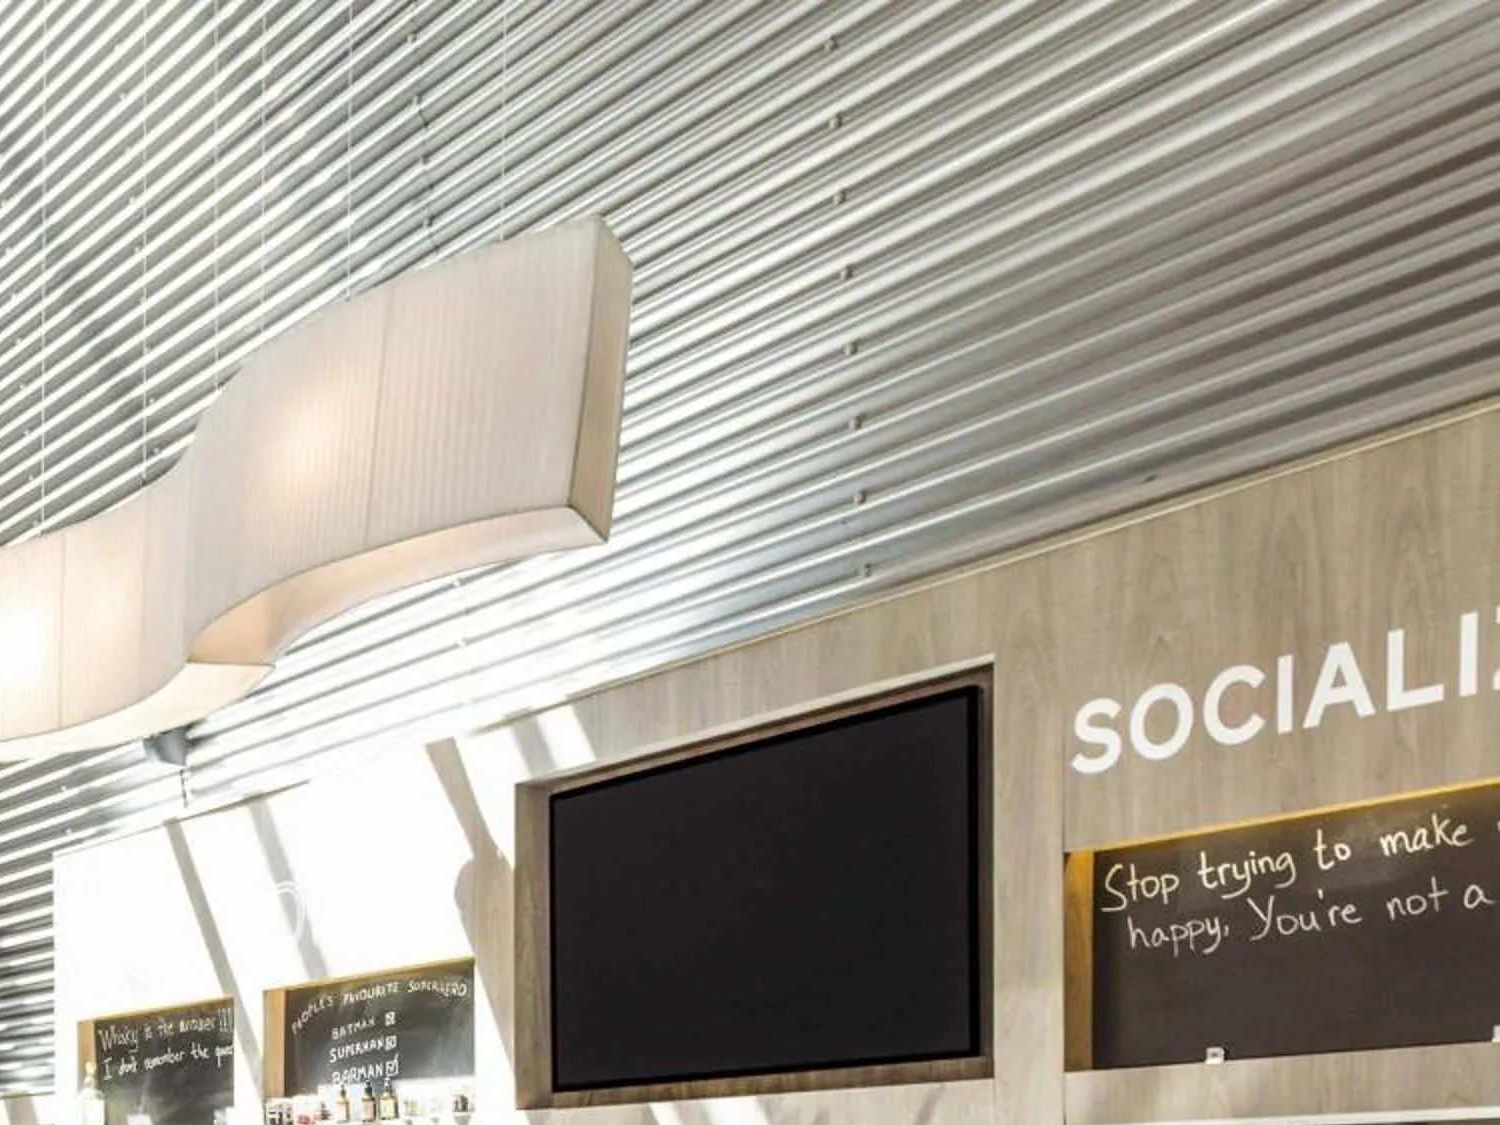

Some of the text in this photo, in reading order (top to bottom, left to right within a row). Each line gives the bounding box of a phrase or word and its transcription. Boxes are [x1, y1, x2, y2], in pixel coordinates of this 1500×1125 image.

[1071, 604, 1500, 774] SOCIALI
[1101, 812, 1474, 912] Stop trying to make
[1385, 875, 1449, 921] not
[1463, 884, 1498, 909] a
[329, 1036, 385, 1063] SUPERMAN
[331, 1017, 376, 1040] BATMAN
